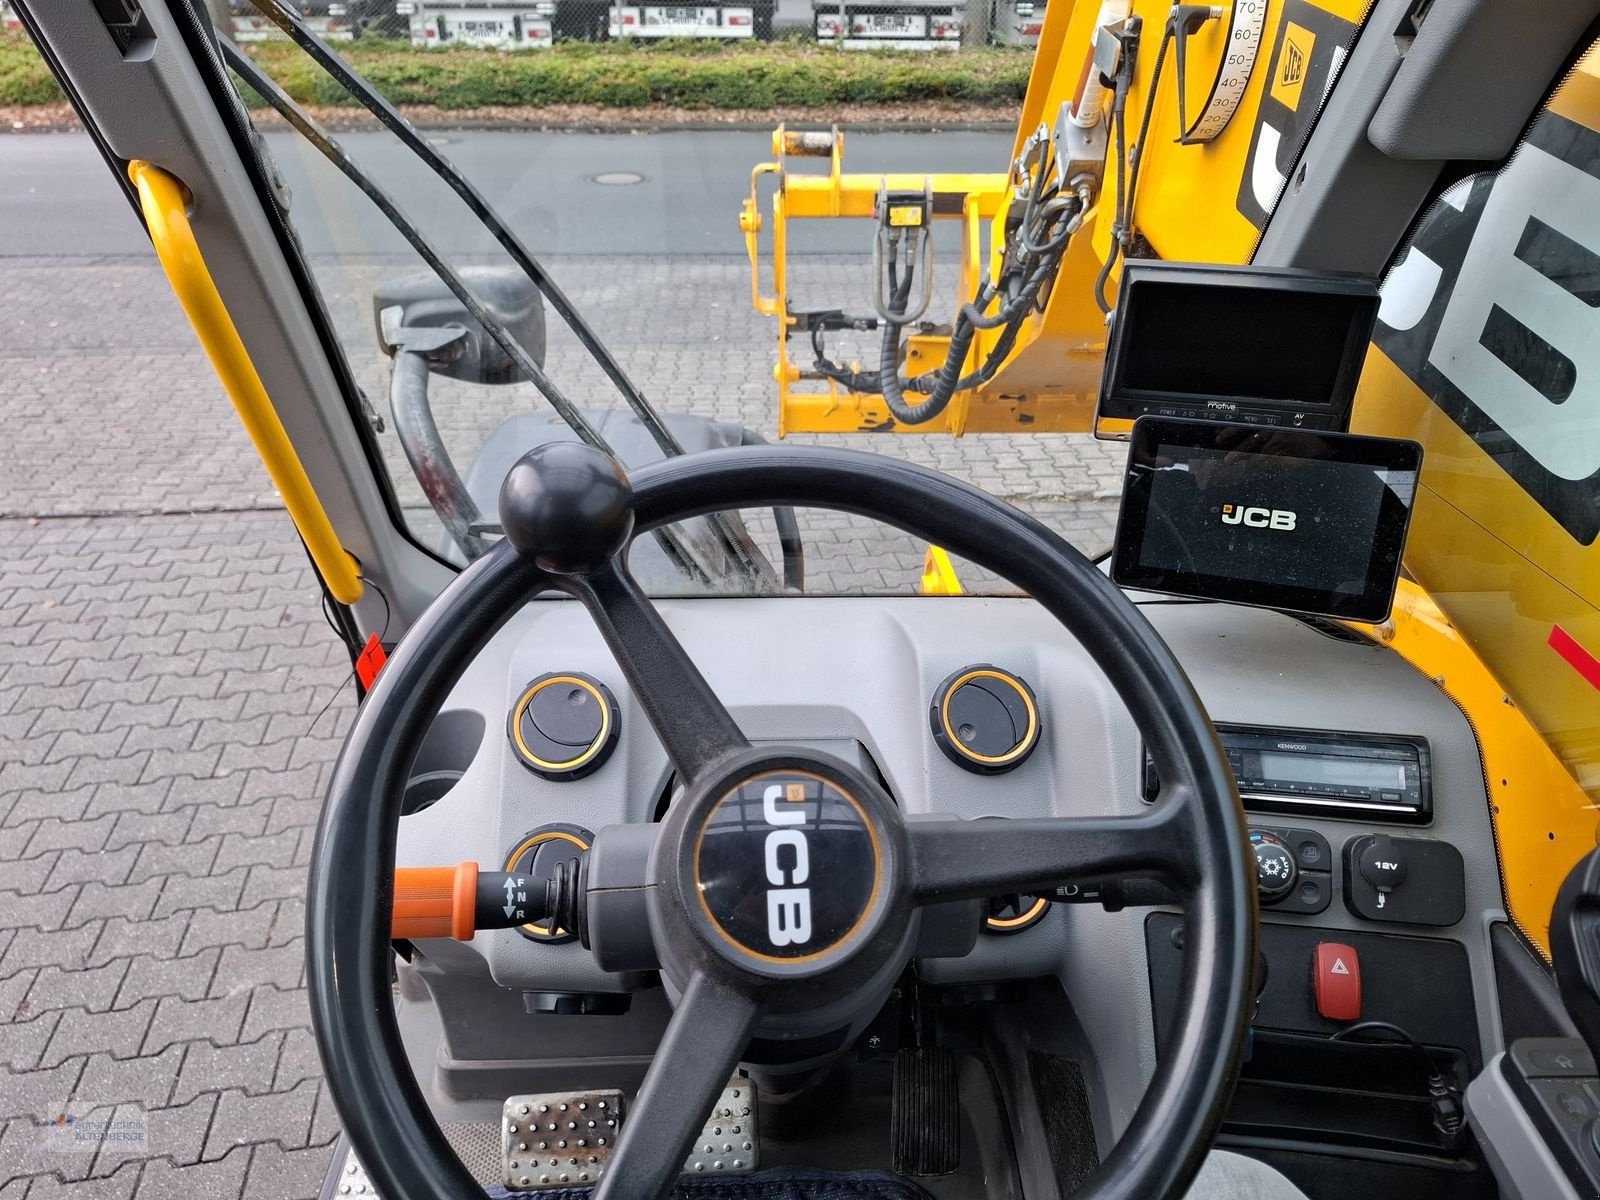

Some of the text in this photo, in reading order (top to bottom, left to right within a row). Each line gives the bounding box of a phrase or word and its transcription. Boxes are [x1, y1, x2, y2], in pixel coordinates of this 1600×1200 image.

[1239, 2, 1256, 14] 70
[1234, 29, 1251, 40] 60
[1228, 55, 1245, 65] 50
[1283, 46, 1303, 82] JCB
[1221, 78, 1238, 88] 40
[1213, 98, 1230, 107] 30
[1204, 115, 1221, 123] 20
[1207, 402, 1237, 411] motive
[1159, 408, 1177, 416] POWER
[1266, 417, 1277, 425] SEL
[1221, 505, 1297, 531] JCB
[1277, 743, 1307, 751] KENWOOD
[763, 784, 813, 947] JCB
[1280, 856, 1290, 879] AUTO
[1374, 861, 1398, 871] 12V
[517, 878, 525, 888] F
[517, 892, 527, 902] N
[516, 910, 526, 919] R
